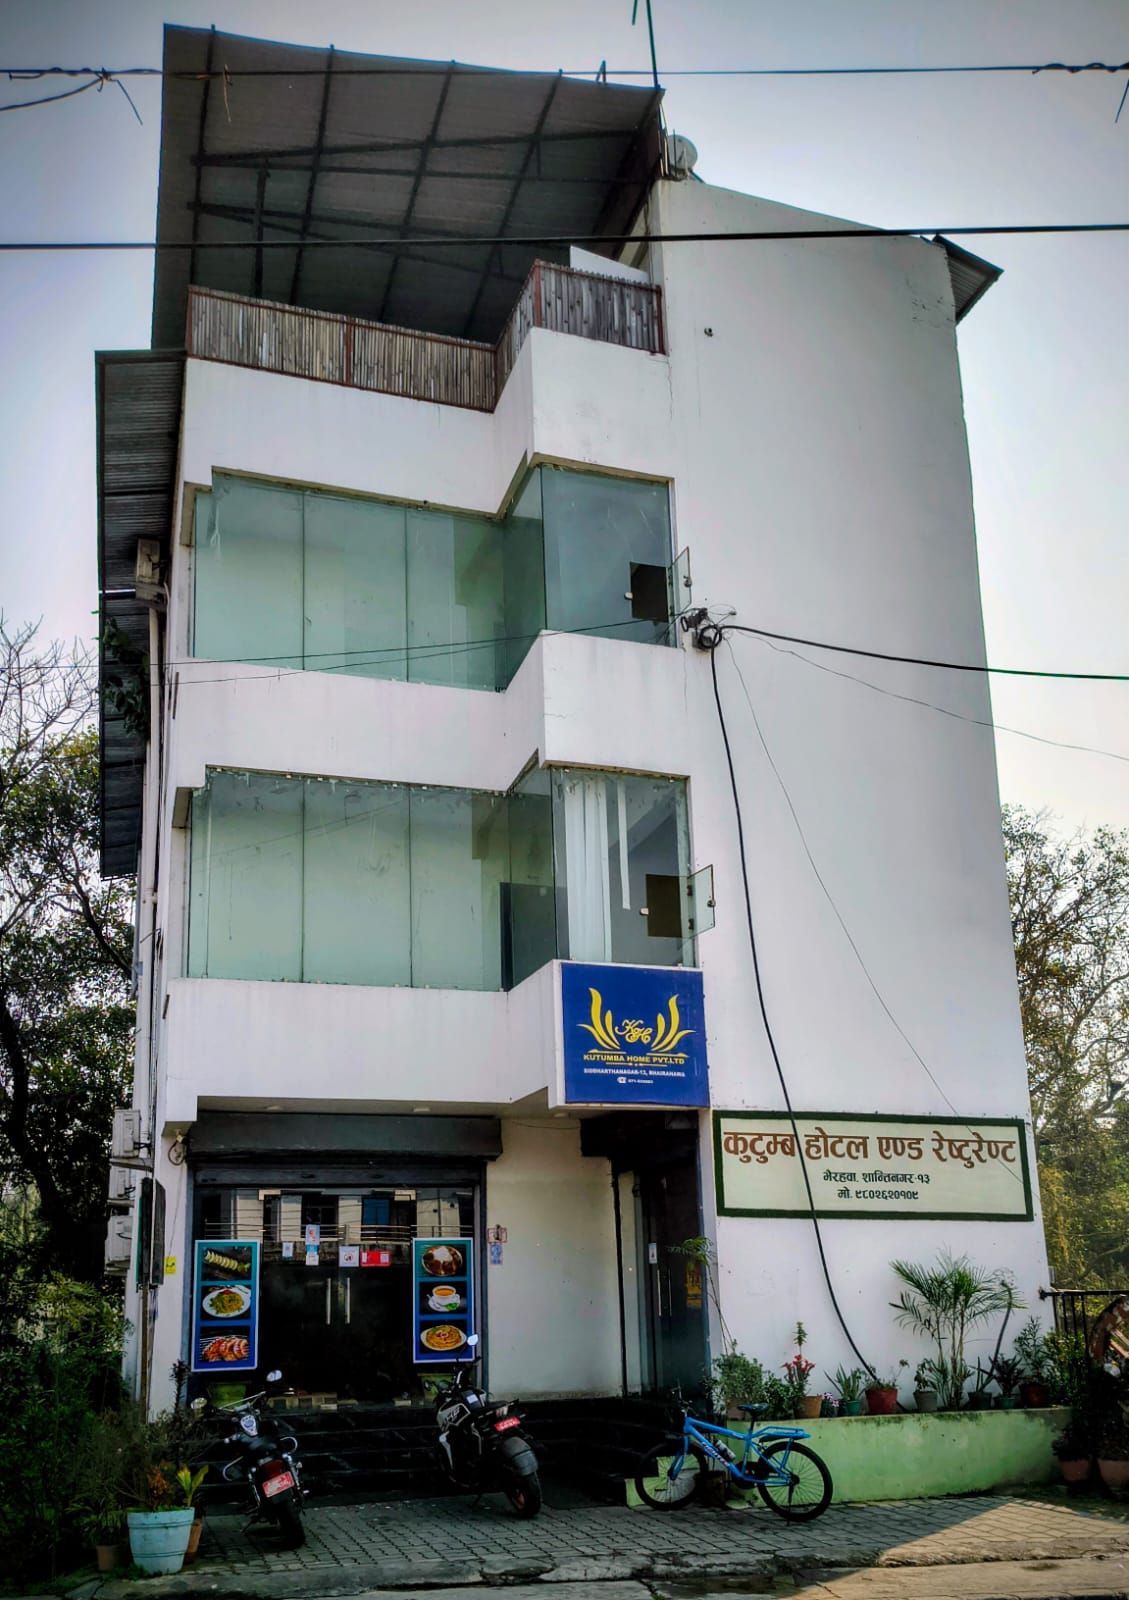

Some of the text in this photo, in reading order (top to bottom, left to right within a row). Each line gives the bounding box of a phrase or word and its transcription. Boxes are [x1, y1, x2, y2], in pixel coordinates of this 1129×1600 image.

[583, 1054, 685, 1065] KUTUMBA HOME PVT.LTD
[723, 1131, 796, 1164] कुटुम्ब
[804, 1126, 870, 1160] होटल
[877, 1136, 925, 1160] एण्ड
